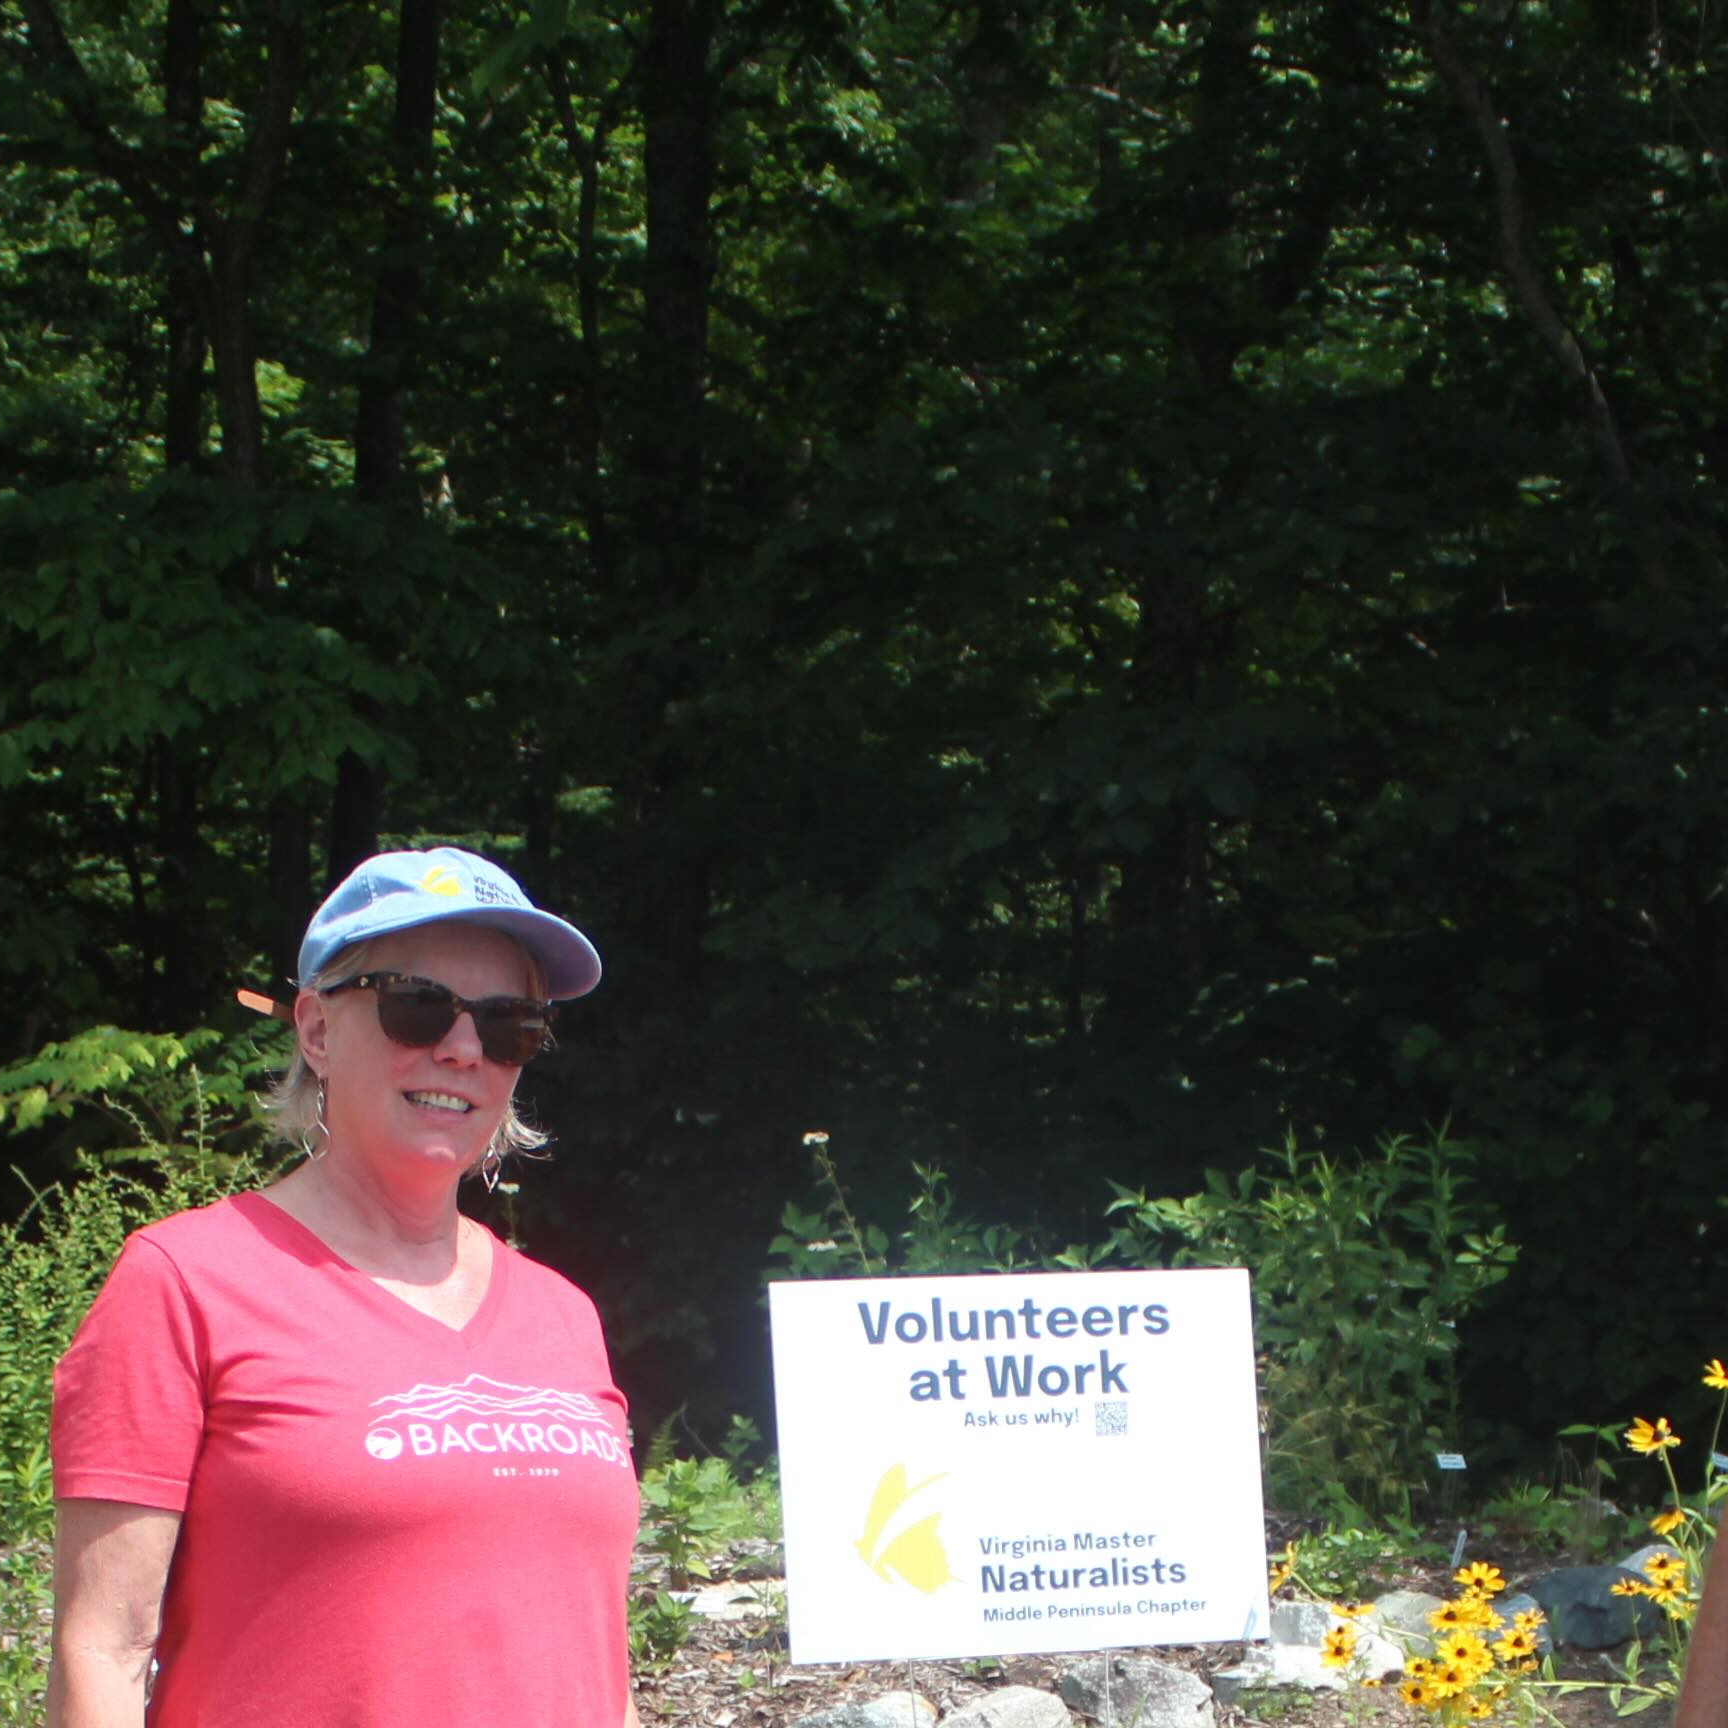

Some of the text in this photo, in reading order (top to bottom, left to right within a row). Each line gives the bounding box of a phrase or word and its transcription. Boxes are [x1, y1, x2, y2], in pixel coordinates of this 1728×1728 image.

[857, 1296, 1171, 1345] Volunteers
[909, 1348, 1130, 1402] at Work
[963, 1407, 1080, 1427] Ask us why!
[407, 1421, 629, 1469] BACKROADS
[978, 1531, 1158, 1560] Virginia Master
[981, 1556, 1188, 1593] Naturalists
[983, 1597, 1208, 1623] Middle Peninsula Chapter
